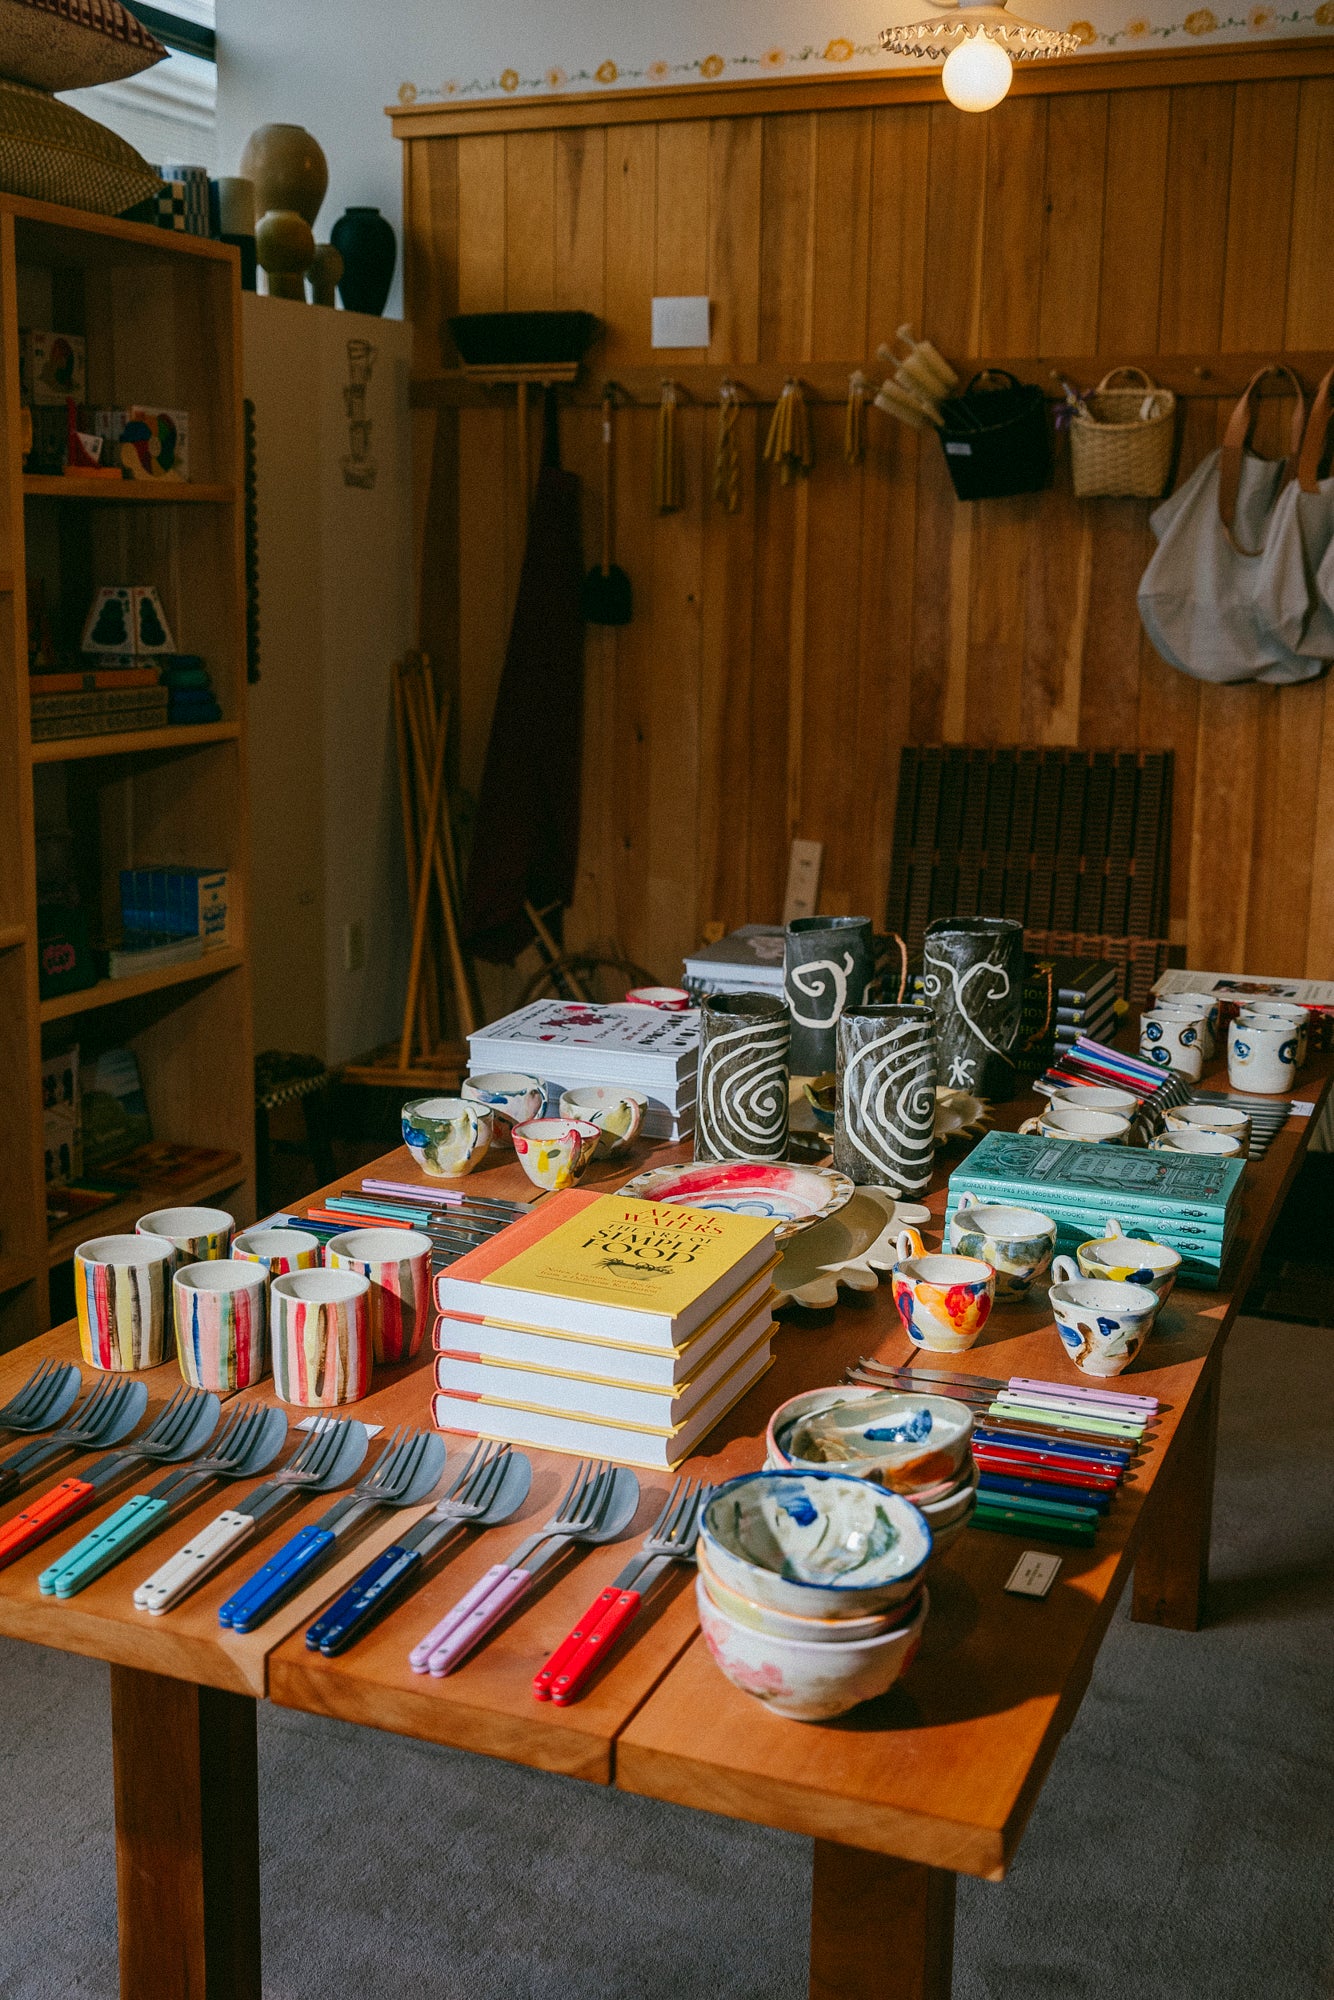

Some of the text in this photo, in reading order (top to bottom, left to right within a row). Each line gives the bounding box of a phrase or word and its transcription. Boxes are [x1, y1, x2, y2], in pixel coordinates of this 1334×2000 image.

[962, 1182, 987, 1190] ROMAN
[989, 1185, 1015, 1194] RECIPES
[1032, 1190, 1061, 1200] MODERN
[1063, 1194, 1086, 1203] COOKS
[1099, 1198, 1114, 1207] Sally
[1115, 1200, 1140, 1210] Grainger
[624, 1213, 724, 1235] WATERS
[638, 1208, 720, 1225] ALICE
[1062, 1211, 1085, 1220] COOKS
[592, 1228, 710, 1255] SIMPLE
[607, 1224, 714, 1244] THE ART OF
[581, 1238, 696, 1264] FOOD
